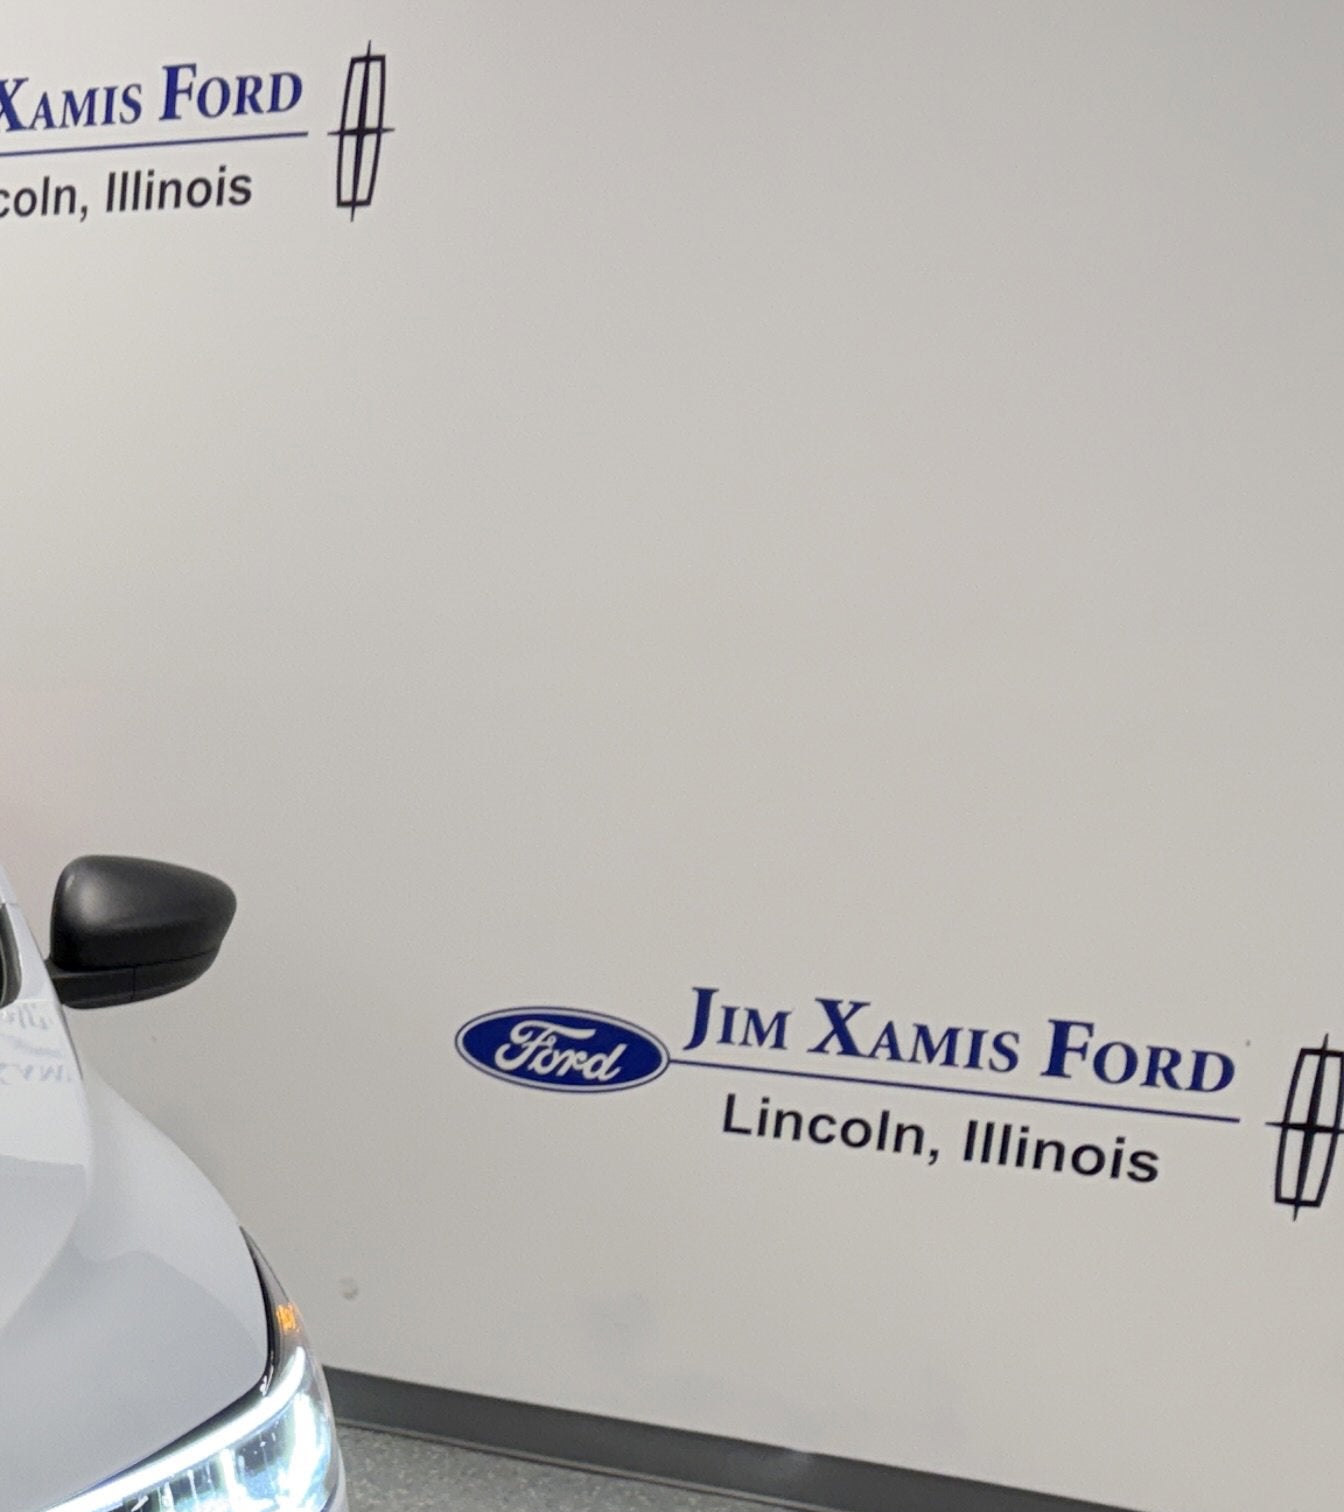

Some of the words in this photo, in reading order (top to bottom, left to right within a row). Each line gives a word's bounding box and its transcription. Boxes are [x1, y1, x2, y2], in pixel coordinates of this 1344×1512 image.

[159, 63, 303, 121] FORD
[106, 165, 253, 212] Illinois
[495, 1018, 628, 1082] Ford
[683, 987, 789, 1051] JIM
[806, 998, 1020, 1074] XAMIS
[1040, 1019, 1236, 1093] FORD
[721, 1092, 940, 1165] Lincoln,
[962, 1119, 1162, 1183] Illinois
